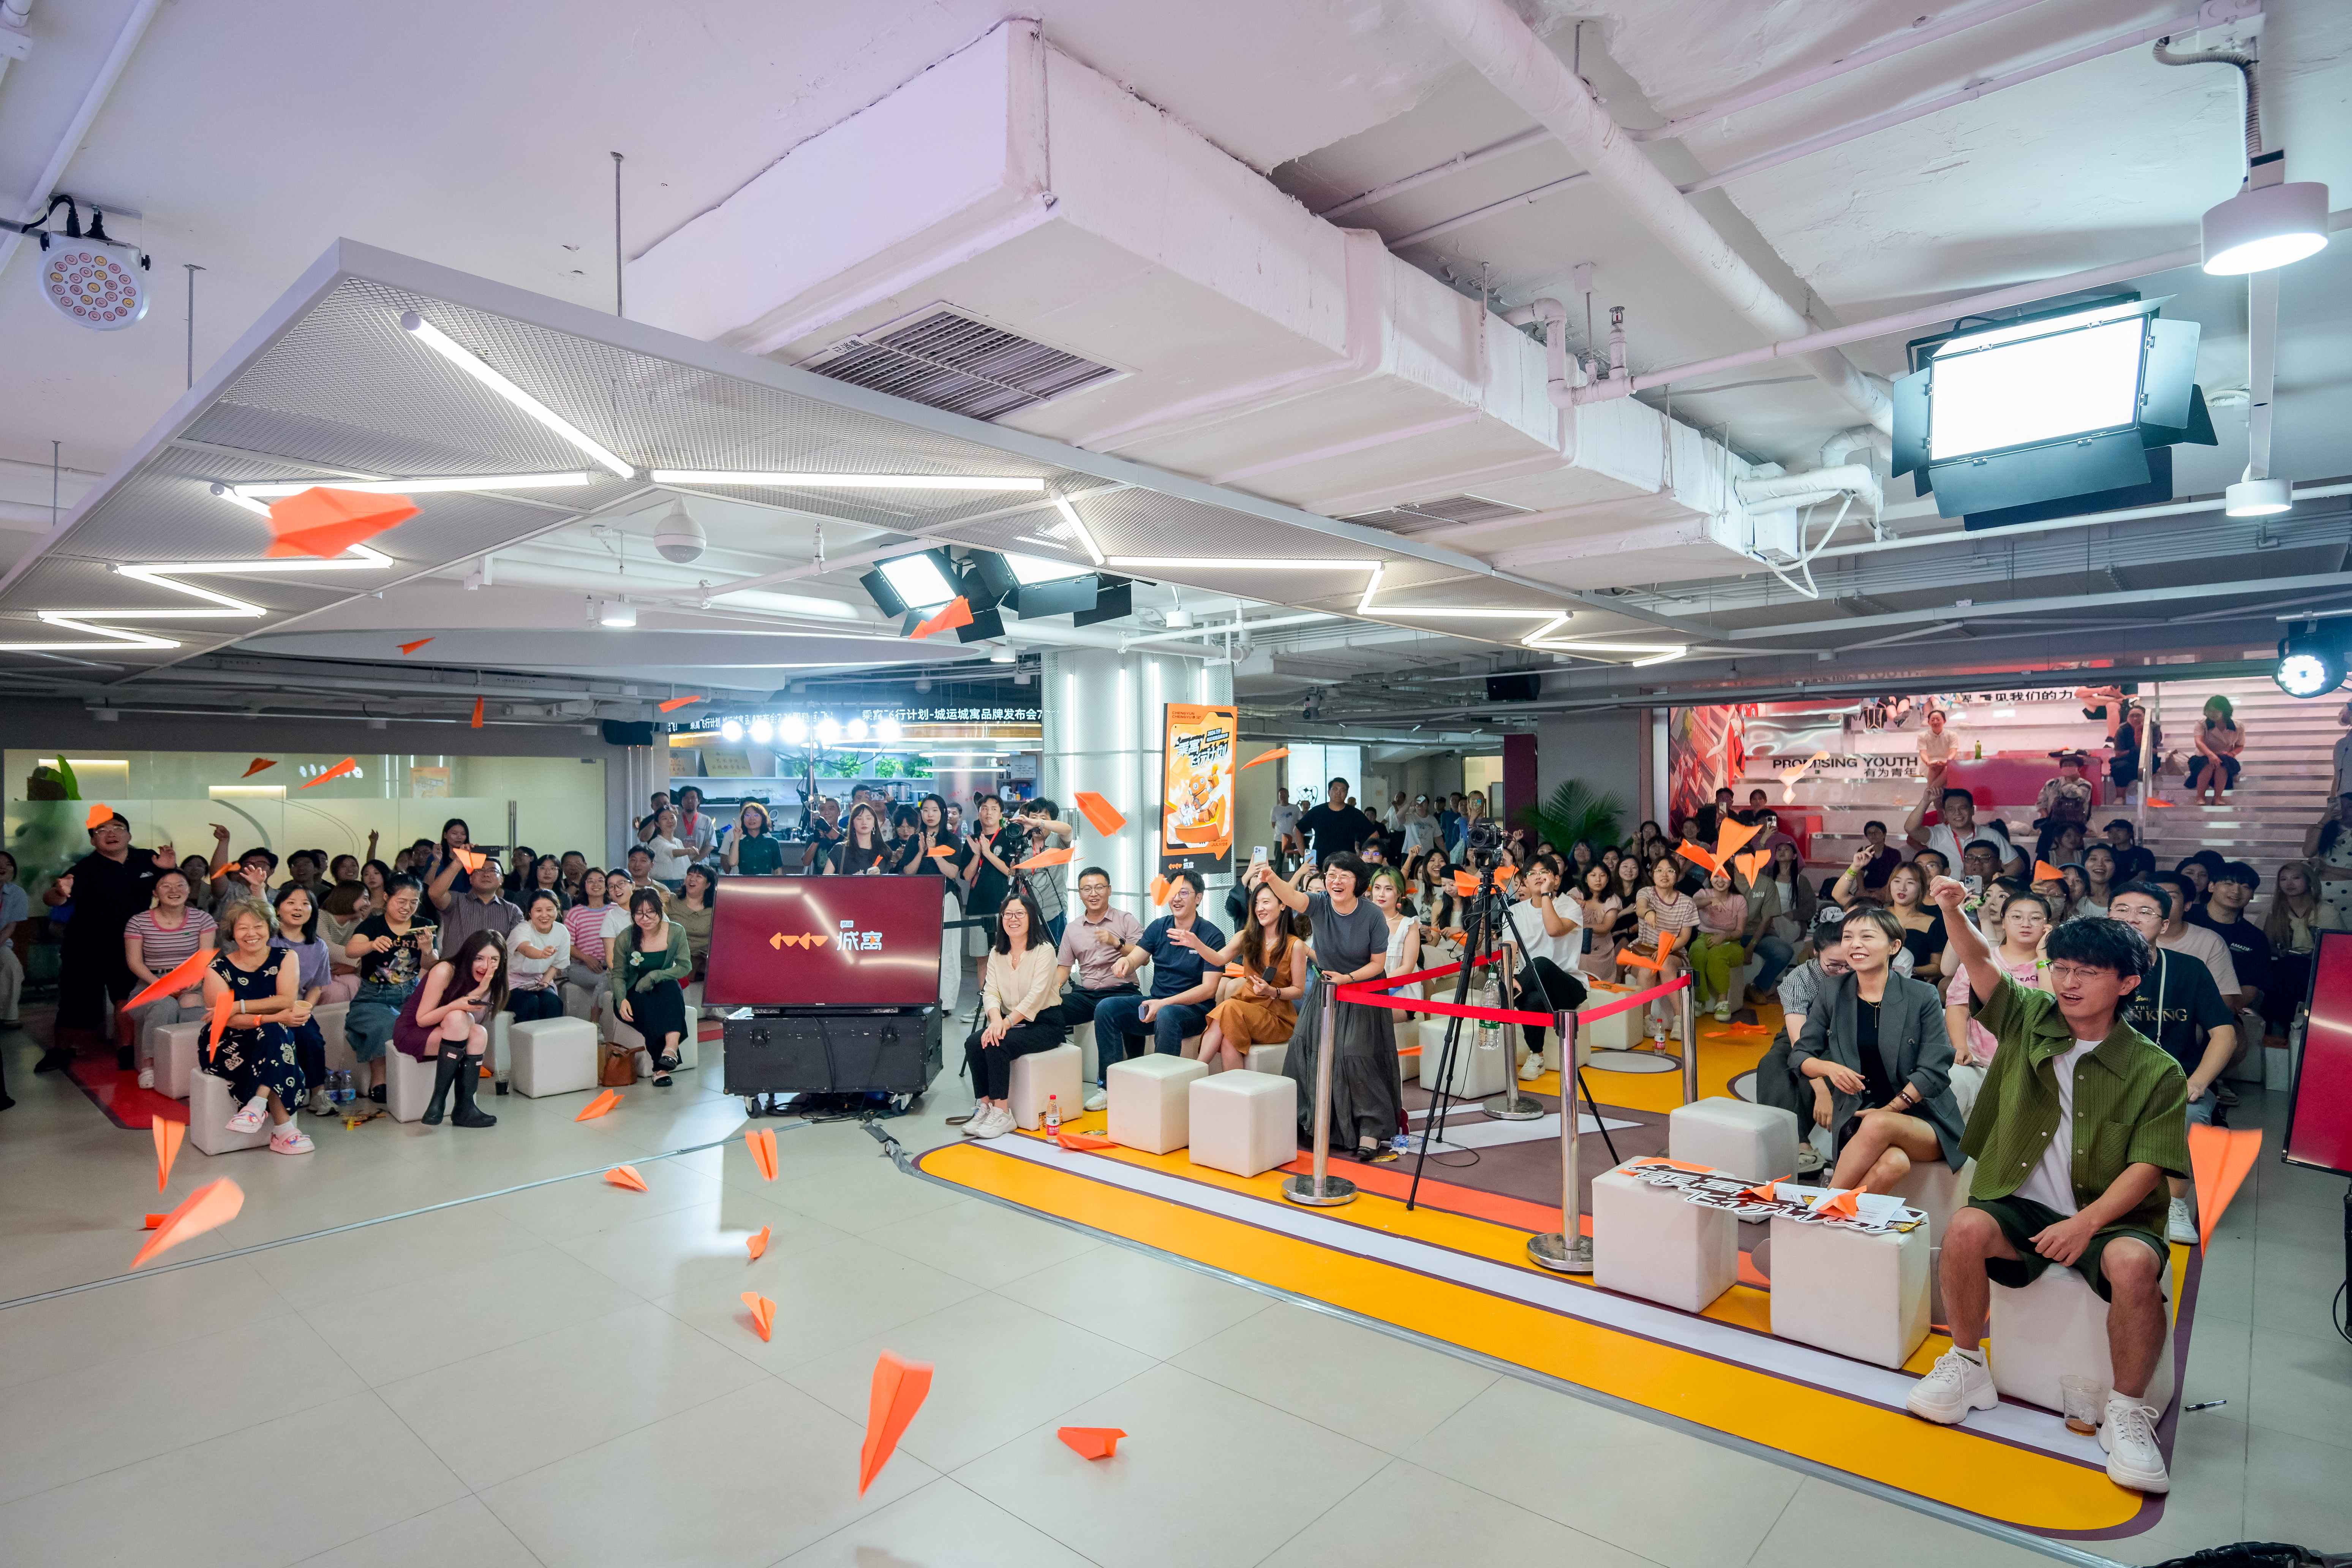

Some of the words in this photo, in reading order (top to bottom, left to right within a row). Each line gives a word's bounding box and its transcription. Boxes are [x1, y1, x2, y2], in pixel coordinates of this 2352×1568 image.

[1864, 757, 1918, 767] YOUTH
[1864, 767, 1917, 778] 有为青年
[2145, 1009, 2188, 1021] KNG
